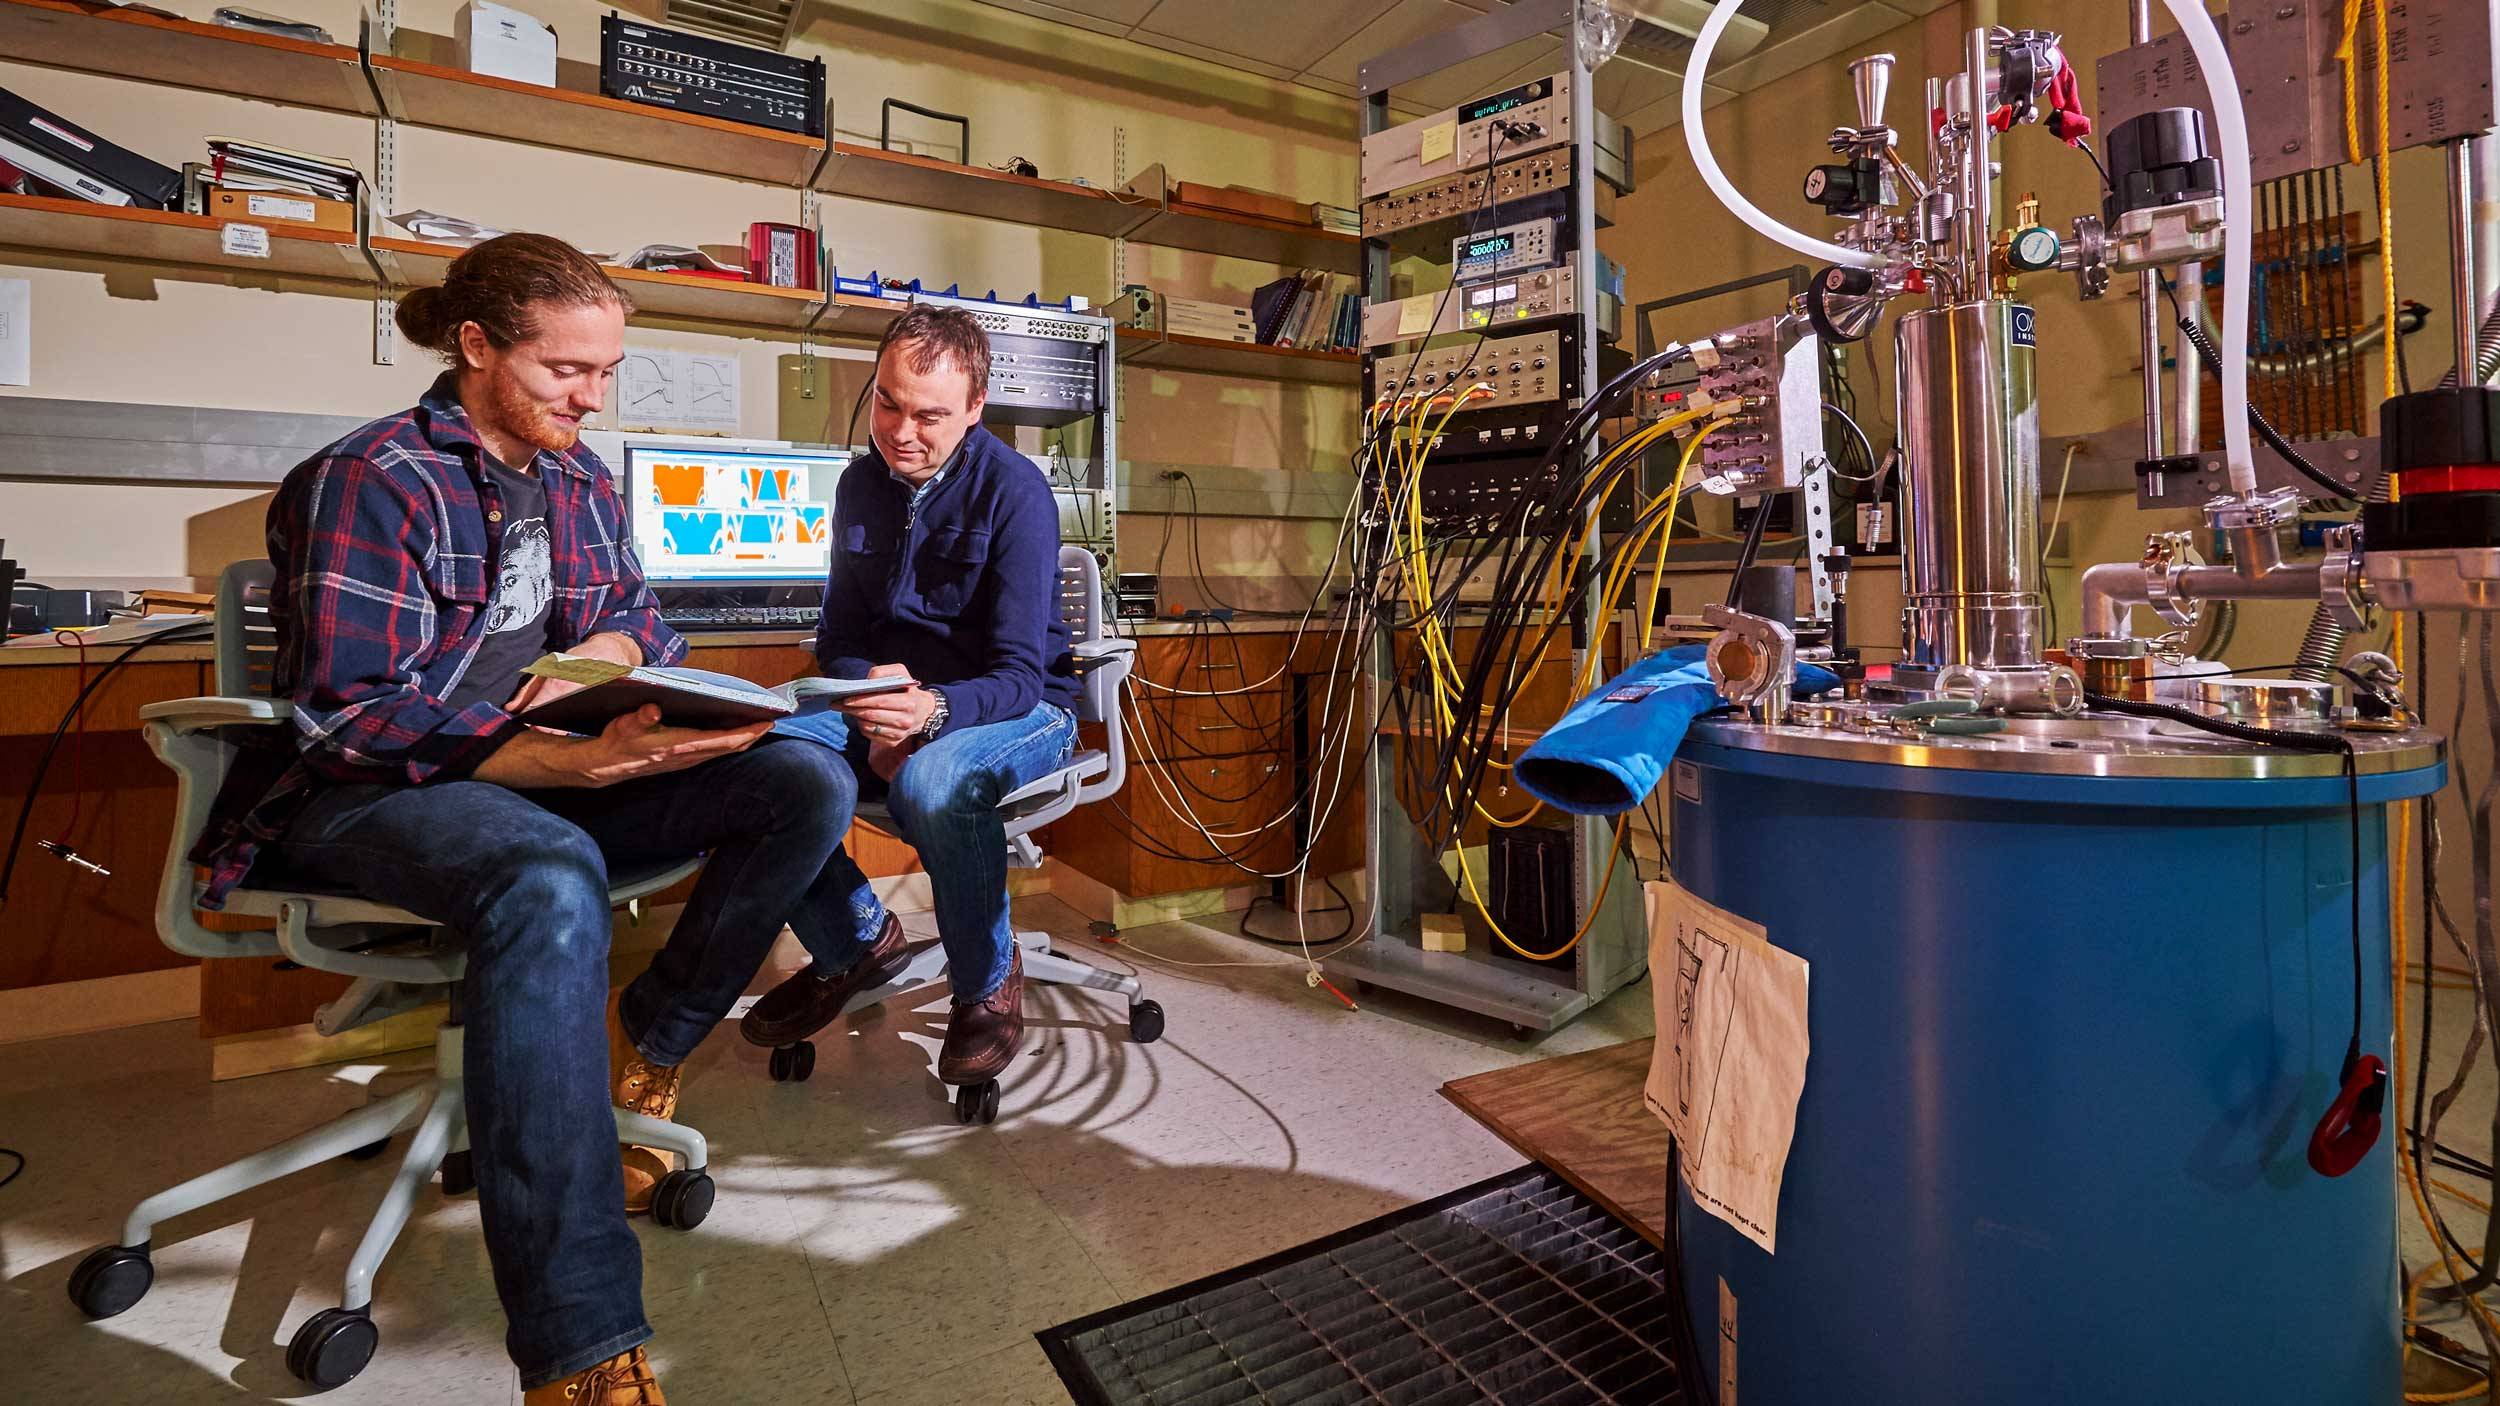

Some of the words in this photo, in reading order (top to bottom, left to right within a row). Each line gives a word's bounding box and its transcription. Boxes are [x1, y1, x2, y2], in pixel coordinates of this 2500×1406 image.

[1710, 1197, 1722, 1207] are
[1723, 1204, 1734, 1215] not
[1735, 1211, 1749, 1225] kept
